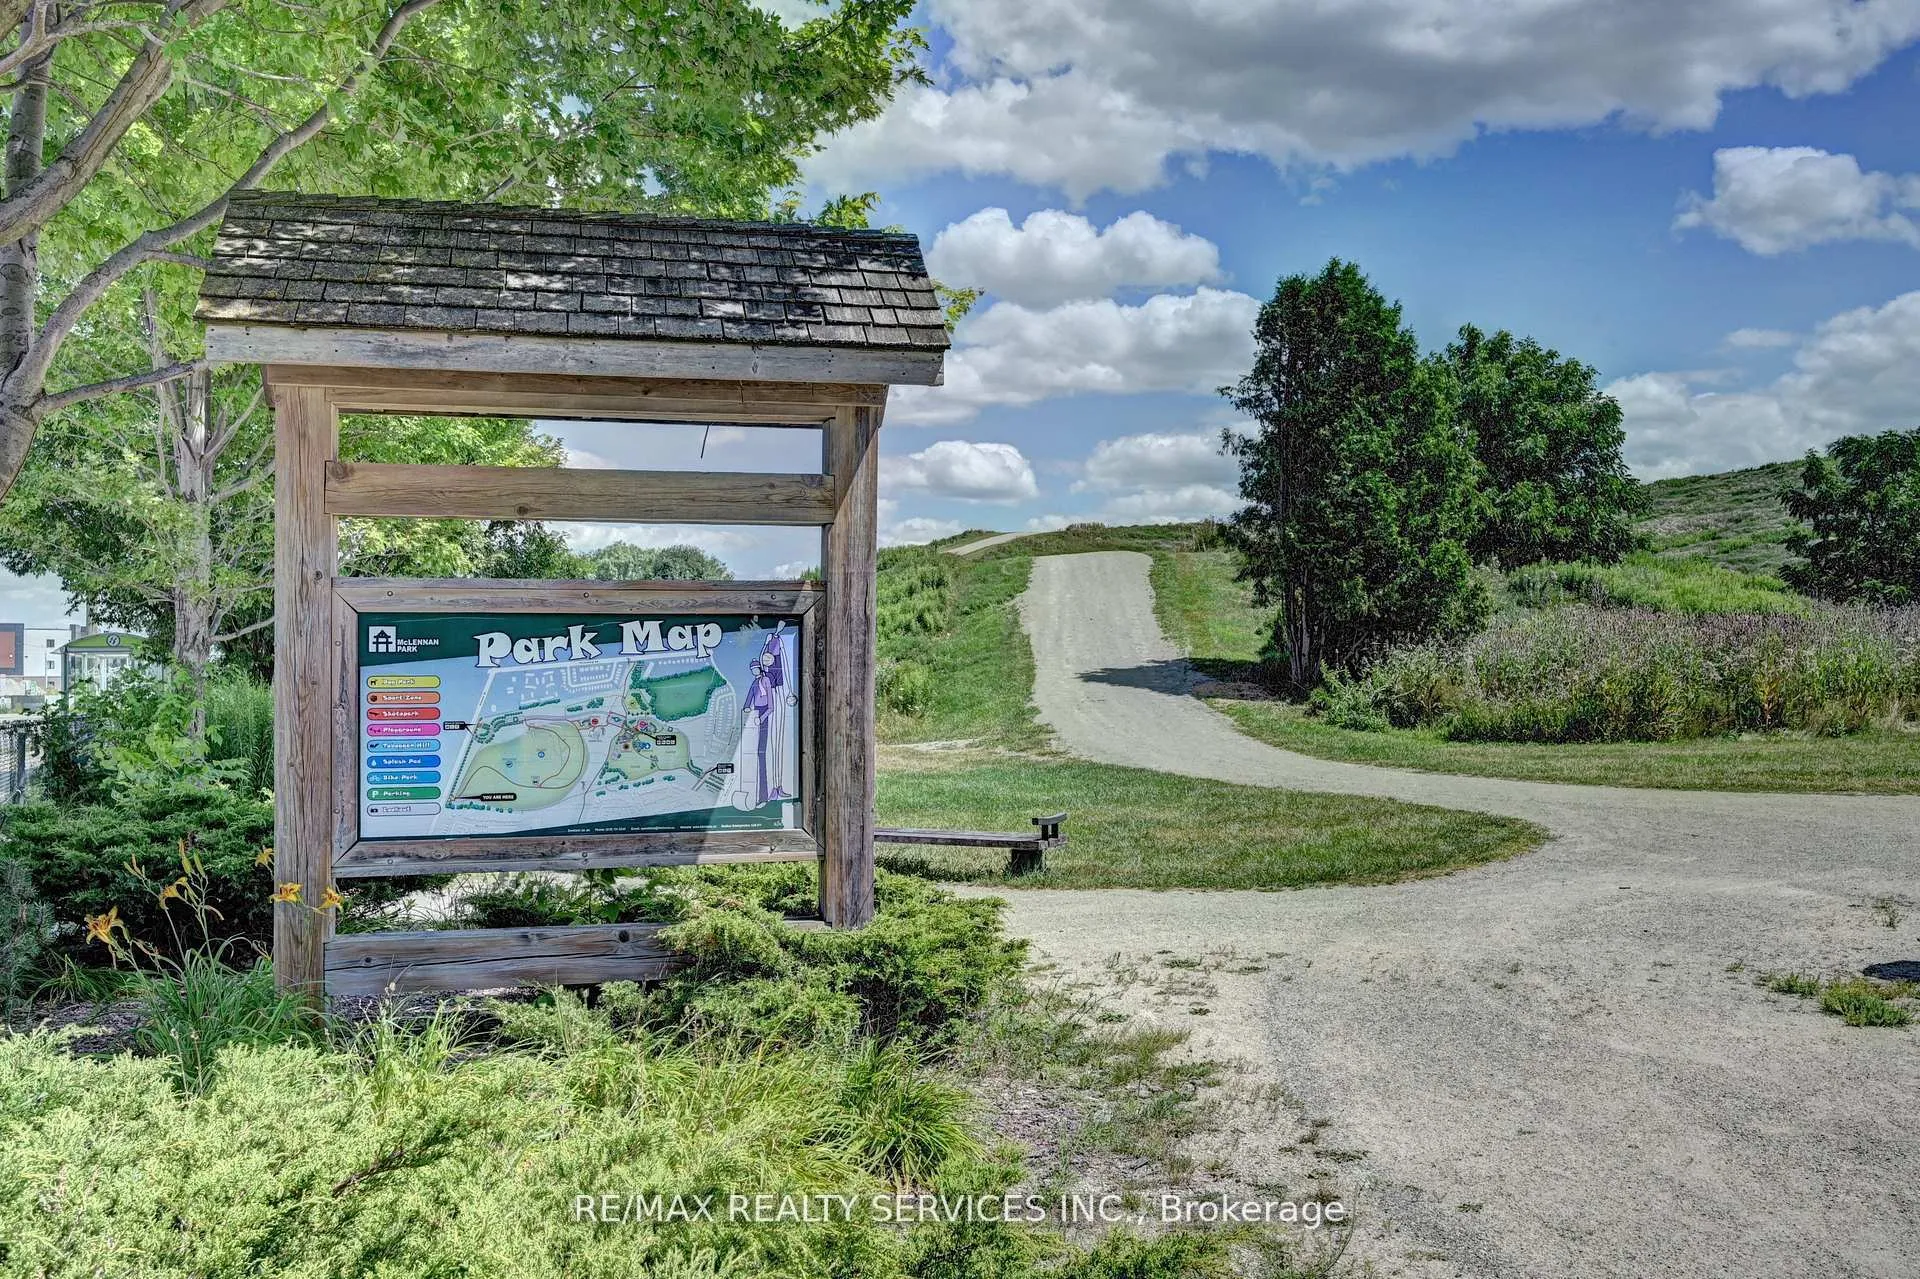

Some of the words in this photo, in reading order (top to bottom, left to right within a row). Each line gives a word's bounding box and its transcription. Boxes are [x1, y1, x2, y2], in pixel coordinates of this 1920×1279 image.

[396, 638, 439, 646] McLENNAN
[471, 623, 603, 669] Park
[618, 619, 724, 660] Map
[396, 645, 418, 653] PARK
